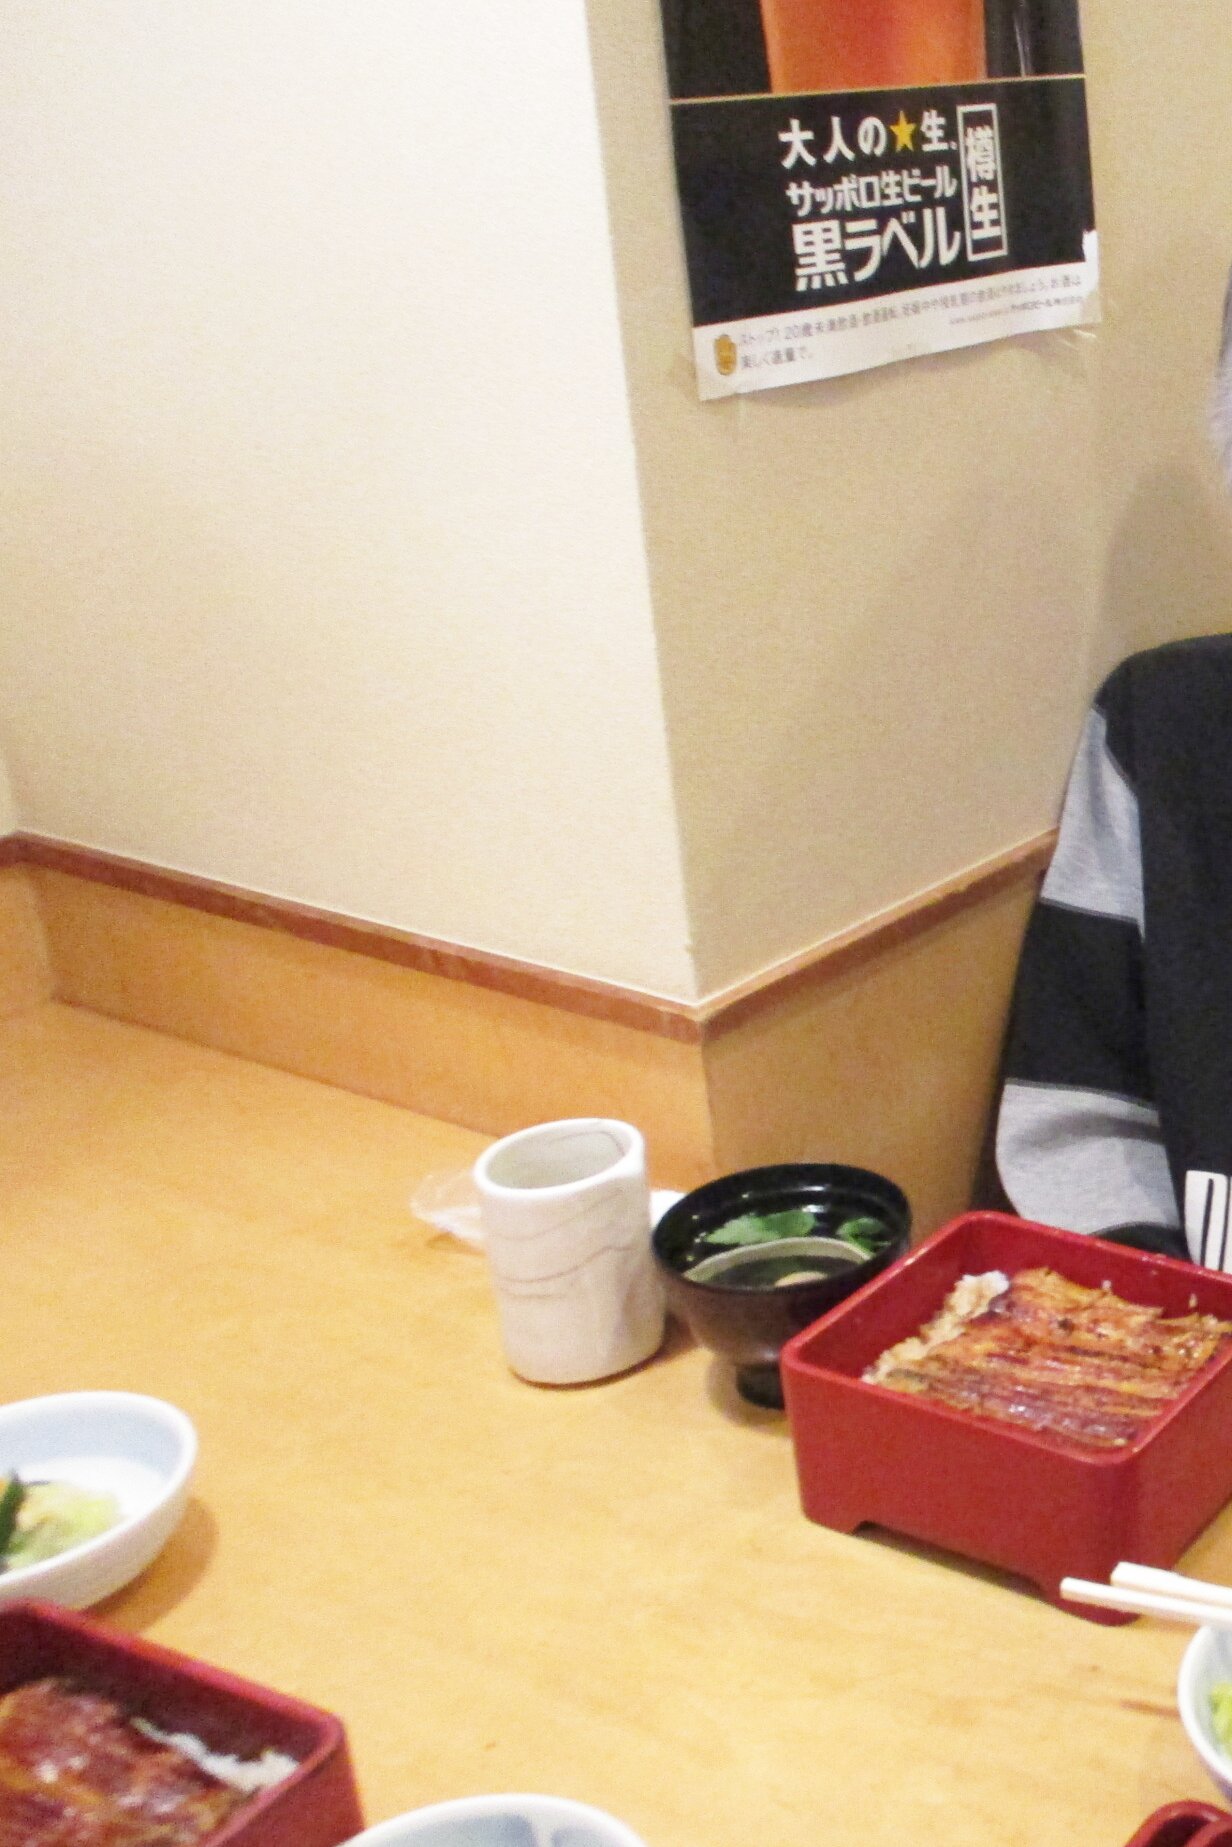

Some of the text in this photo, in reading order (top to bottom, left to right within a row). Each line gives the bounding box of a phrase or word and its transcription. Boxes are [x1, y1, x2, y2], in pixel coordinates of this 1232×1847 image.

[786, 164, 958, 217] サッポロ生ビール
[965, 124, 1003, 240] 樽生
[792, 206, 962, 292] 黒ラベル
